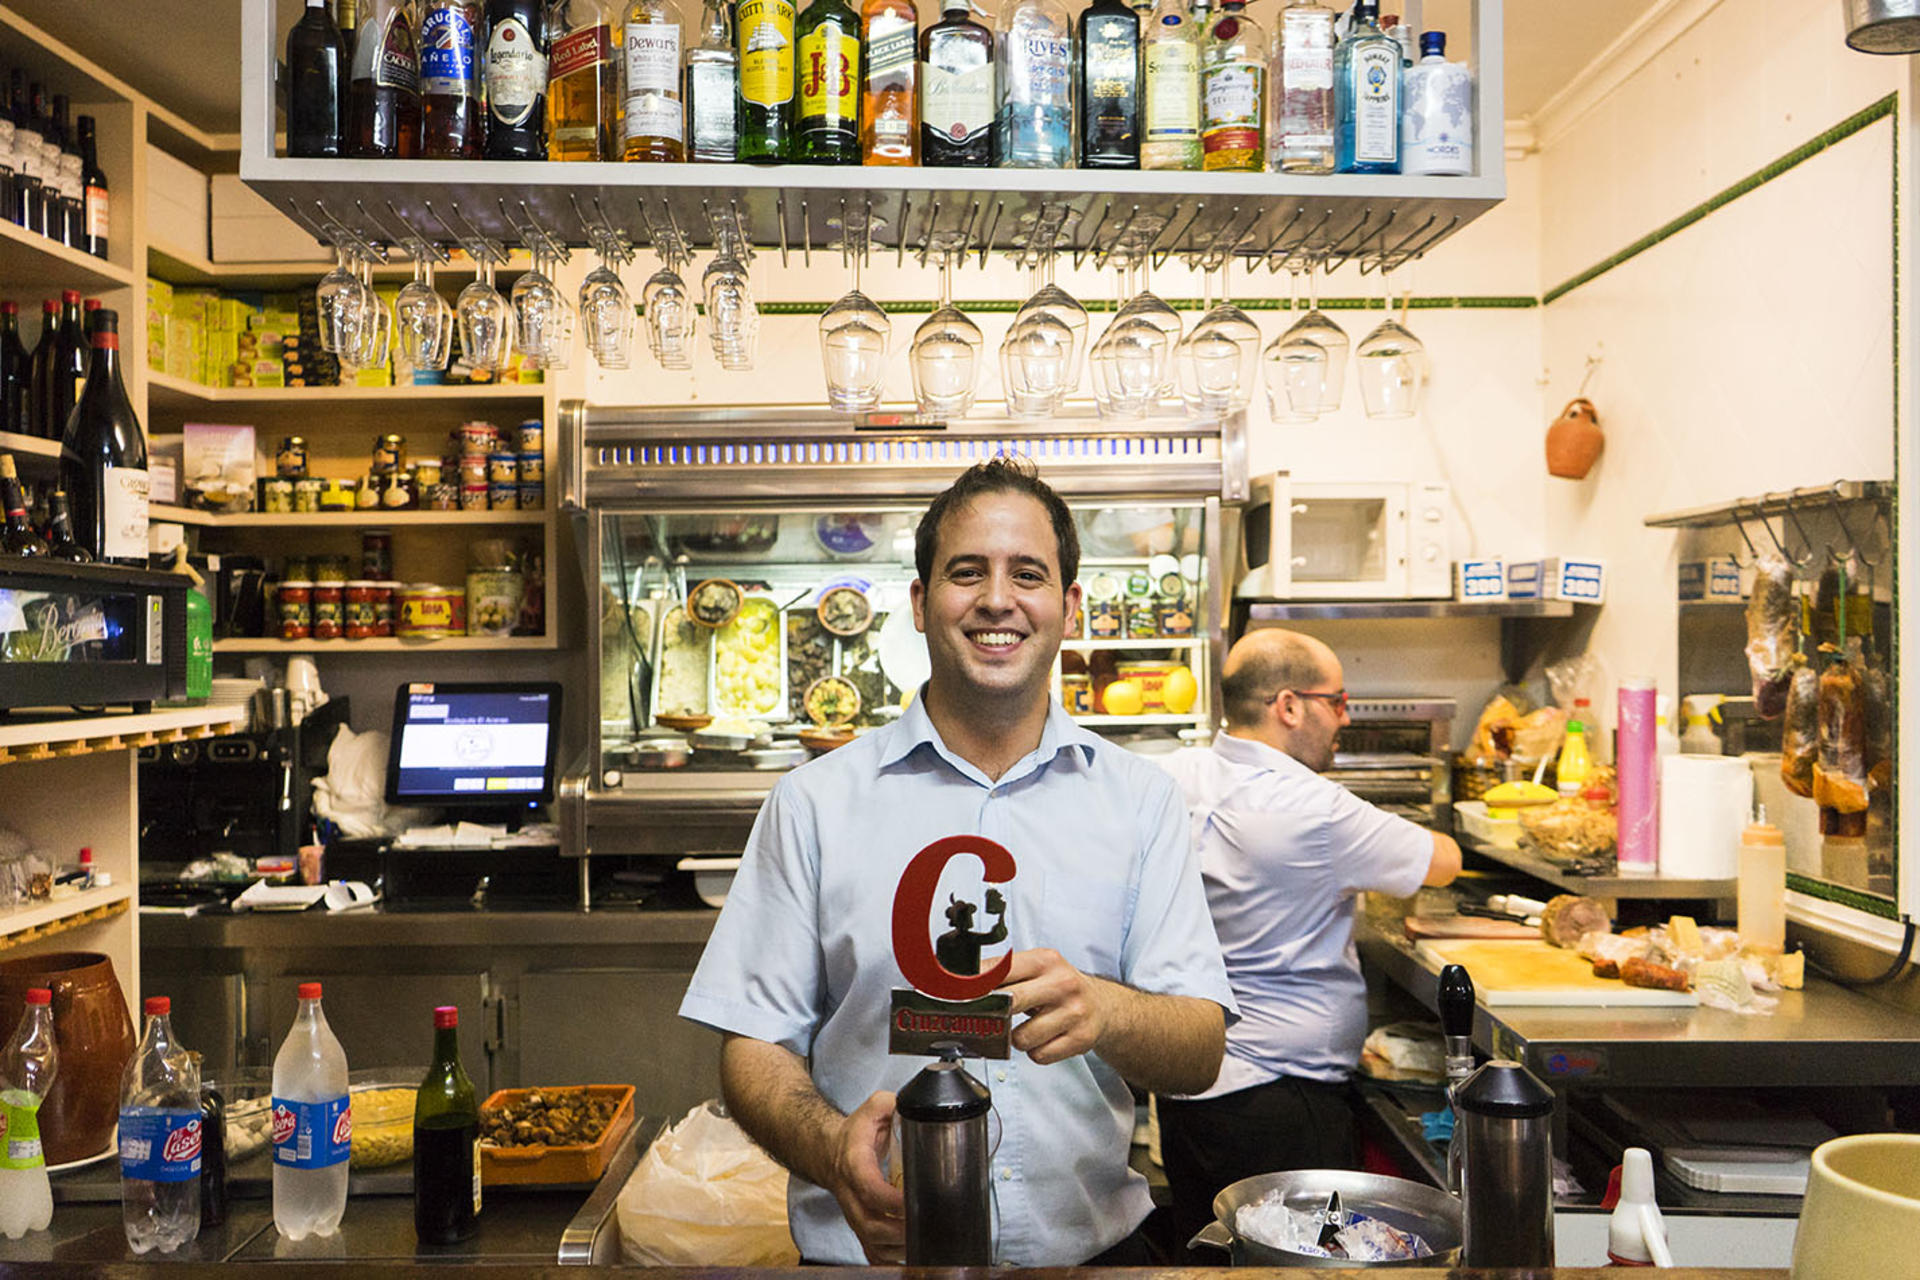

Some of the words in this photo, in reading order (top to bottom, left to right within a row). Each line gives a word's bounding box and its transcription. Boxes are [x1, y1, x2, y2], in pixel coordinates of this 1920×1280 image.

[552, 49, 573, 64] Red
[571, 37, 599, 55] Label
[804, 51, 851, 98] J&B
[896, 1008, 1005, 1037] Cruzcampo
